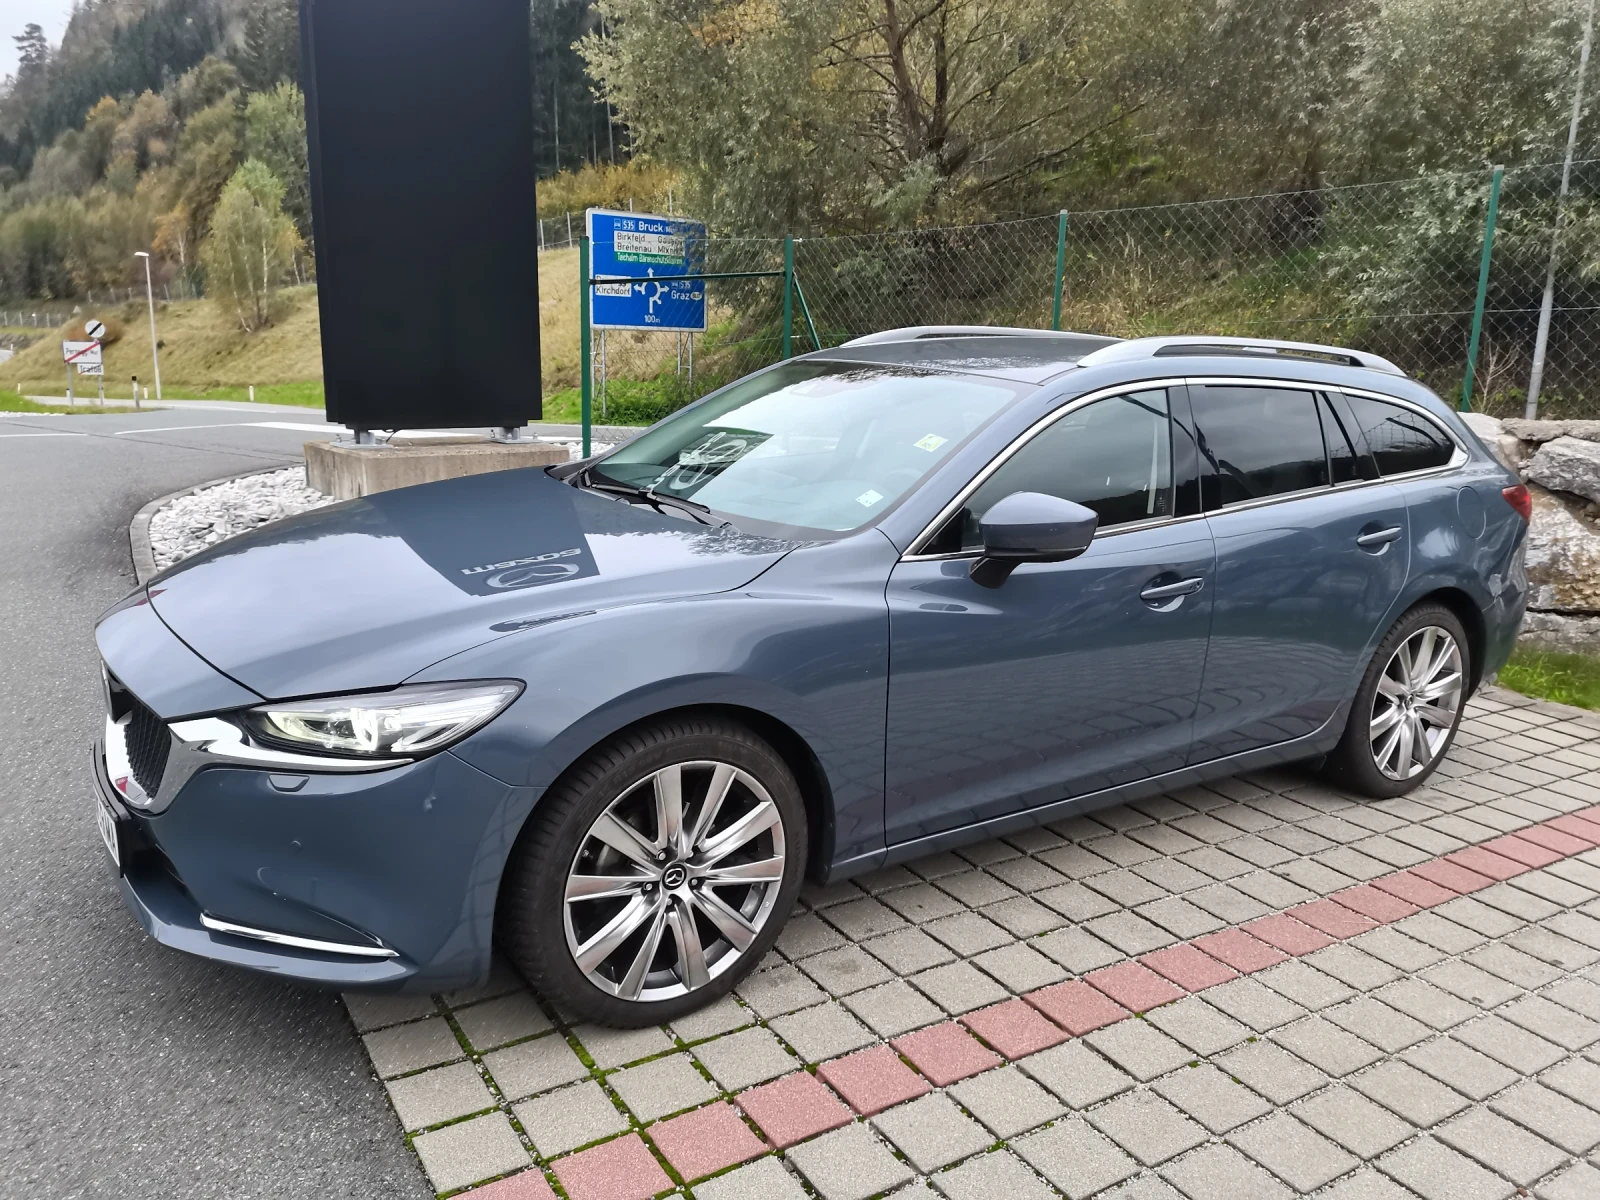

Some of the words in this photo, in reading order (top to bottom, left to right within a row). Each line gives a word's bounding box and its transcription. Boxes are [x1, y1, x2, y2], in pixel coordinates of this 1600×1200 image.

[638, 222, 663, 232] Bruck
[617, 233, 646, 242] Birkfeld
[617, 243, 652, 253] Breitenau
[596, 286, 631, 295] Kirchdorf
[671, 290, 690, 300] Graz
